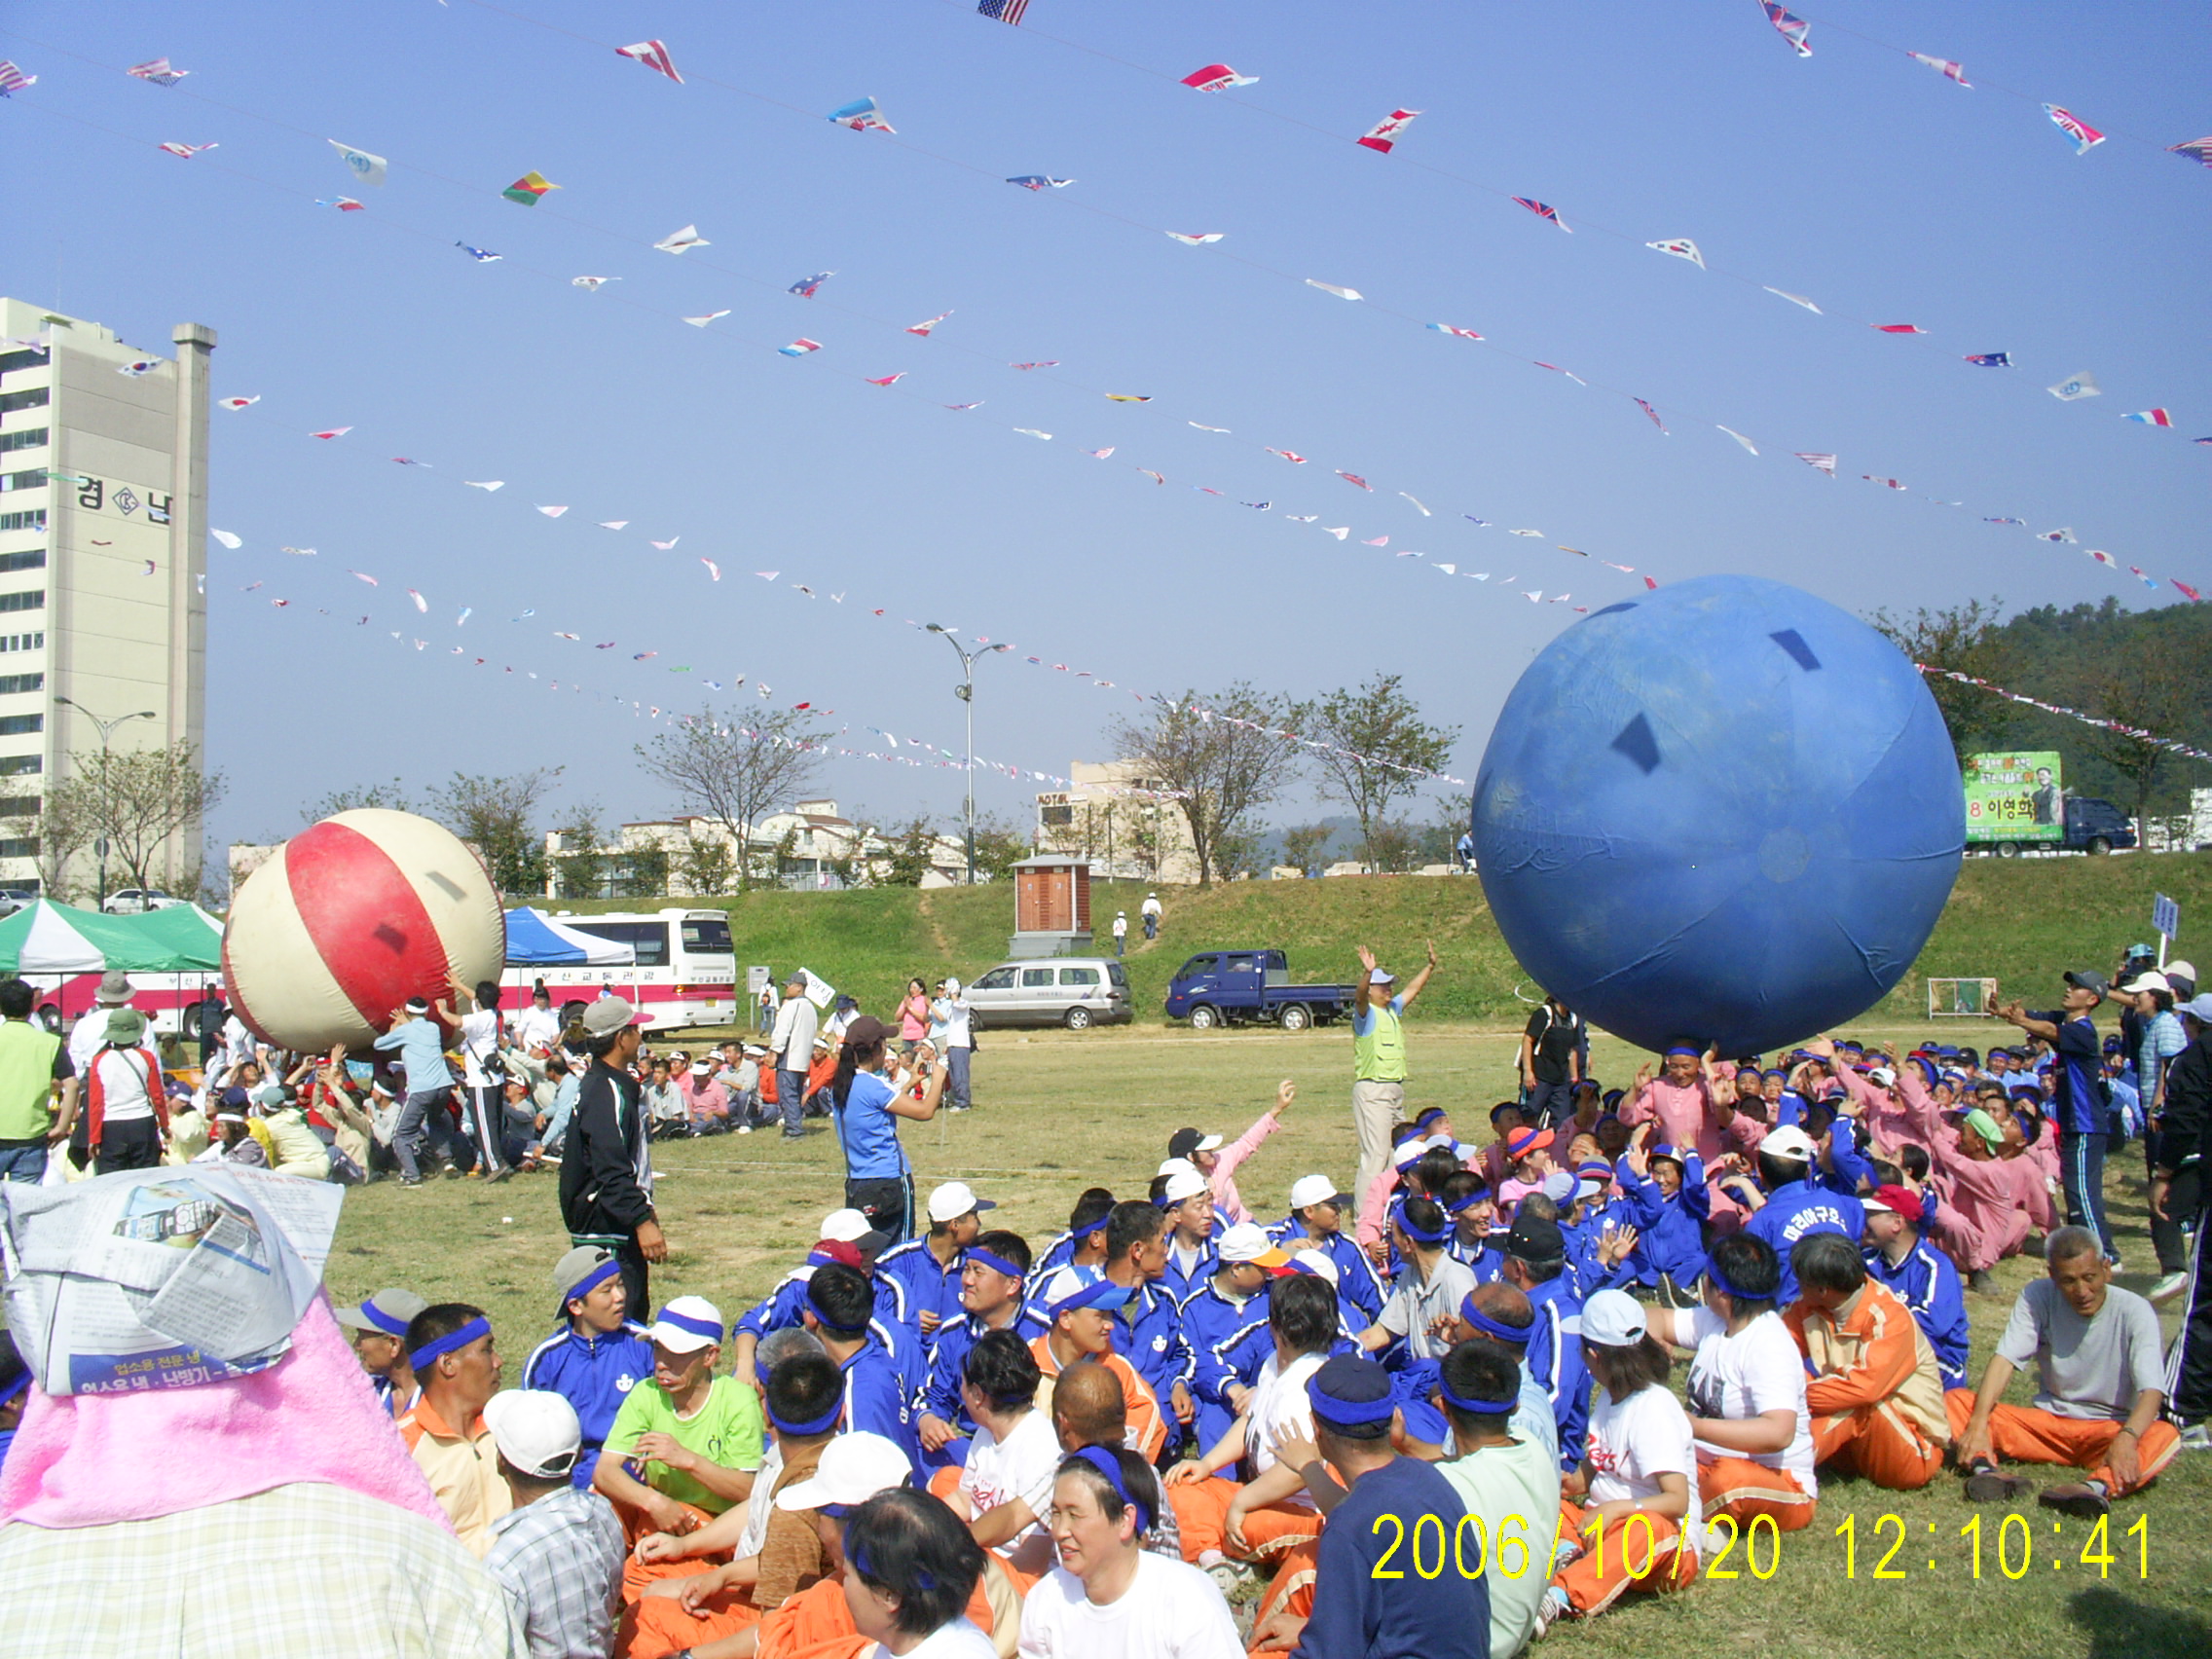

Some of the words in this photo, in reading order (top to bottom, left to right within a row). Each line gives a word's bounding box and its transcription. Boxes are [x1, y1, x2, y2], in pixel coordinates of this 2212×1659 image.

[1971, 801, 1981, 818] 8
[114, 1358, 154, 1376] 업소용
[158, 1354, 184, 1370] 전문
